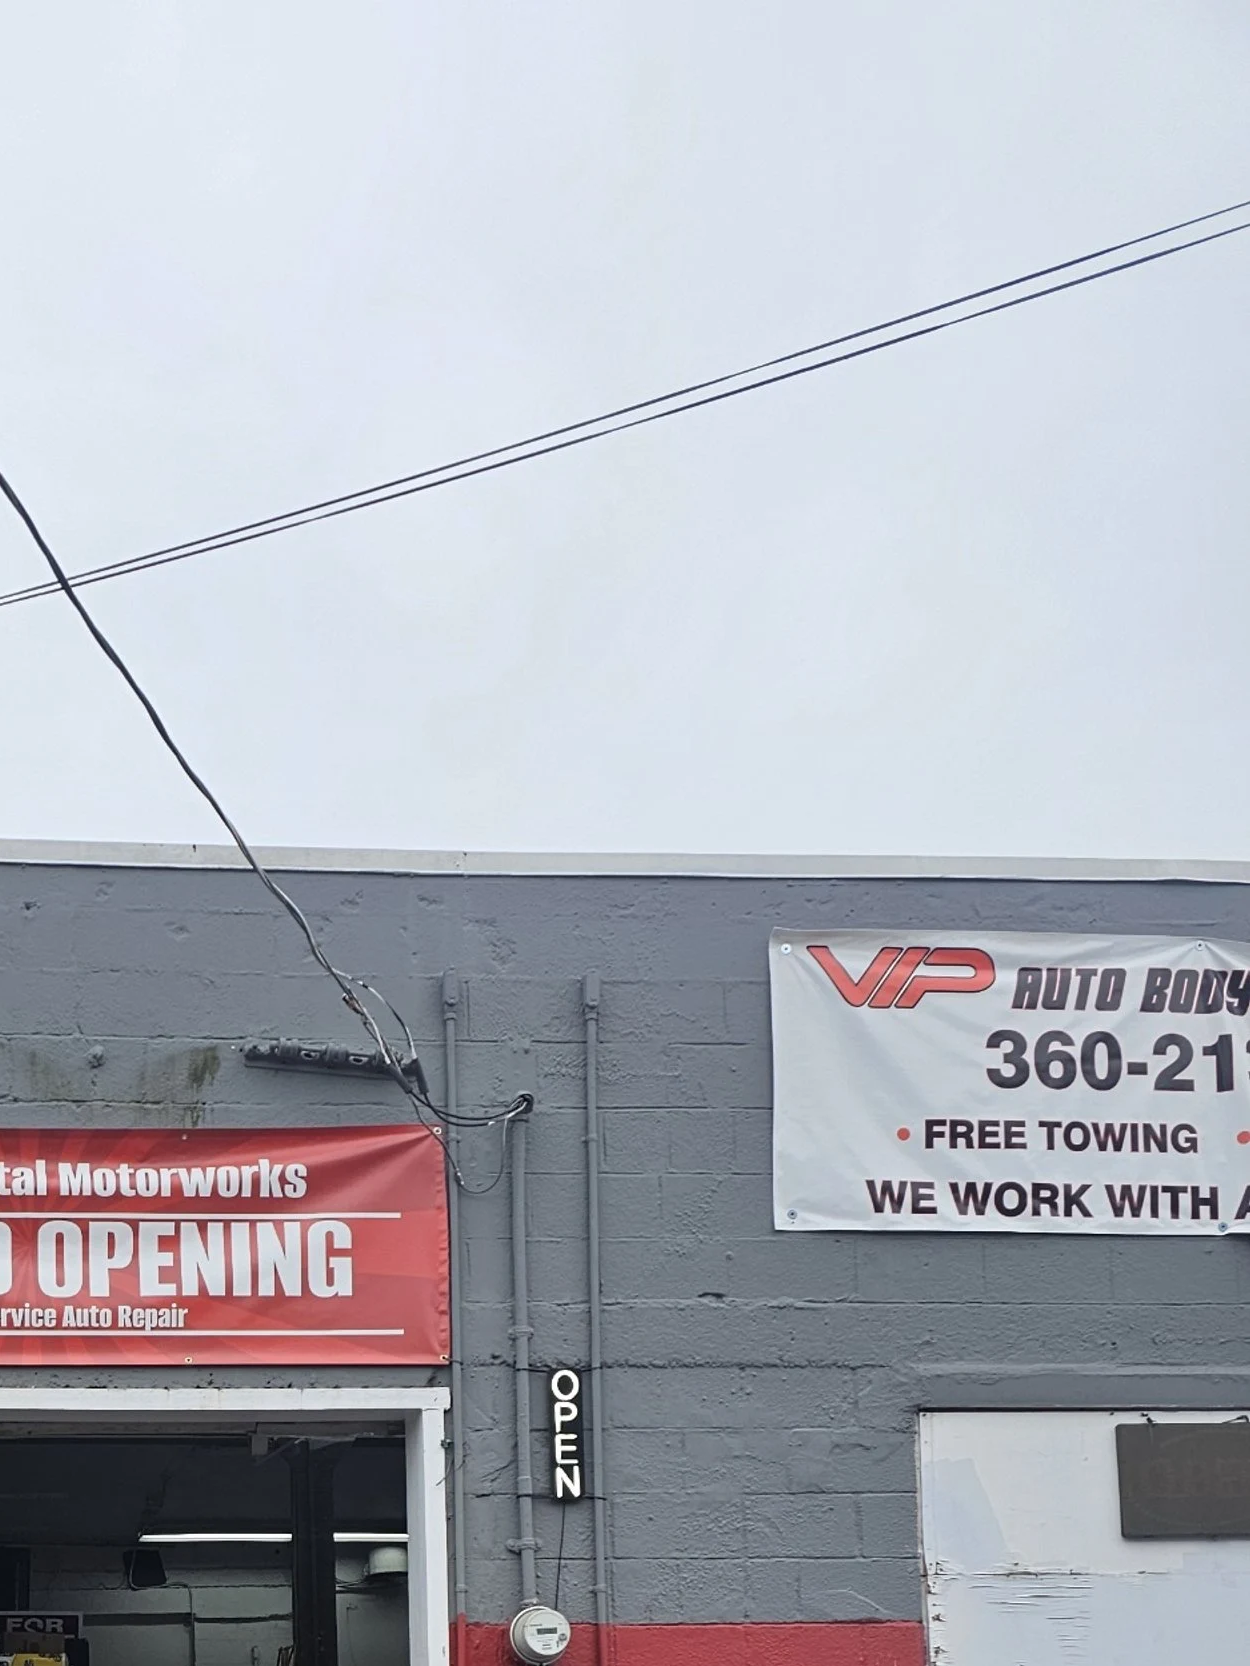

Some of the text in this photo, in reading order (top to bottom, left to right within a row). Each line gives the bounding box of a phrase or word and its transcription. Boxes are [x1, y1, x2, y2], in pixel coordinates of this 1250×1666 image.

[806, 945, 996, 1008] VIP
[1011, 967, 1250, 1017] AUTO BODY
[985, 1029, 1250, 1093] 360-21
[924, 1118, 1199, 1154] FREE TOWING
[58, 1160, 307, 1199] Motorworks
[865, 1178, 938, 1216] WE
[949, 1181, 1093, 1219] WORK
[1104, 1183, 1220, 1221] WITH
[36, 1219, 354, 1299] OPENING
[61, 1304, 112, 1329] Auto
[117, 1304, 188, 1332] Repair
[550, 1369, 581, 1498] OPEN
